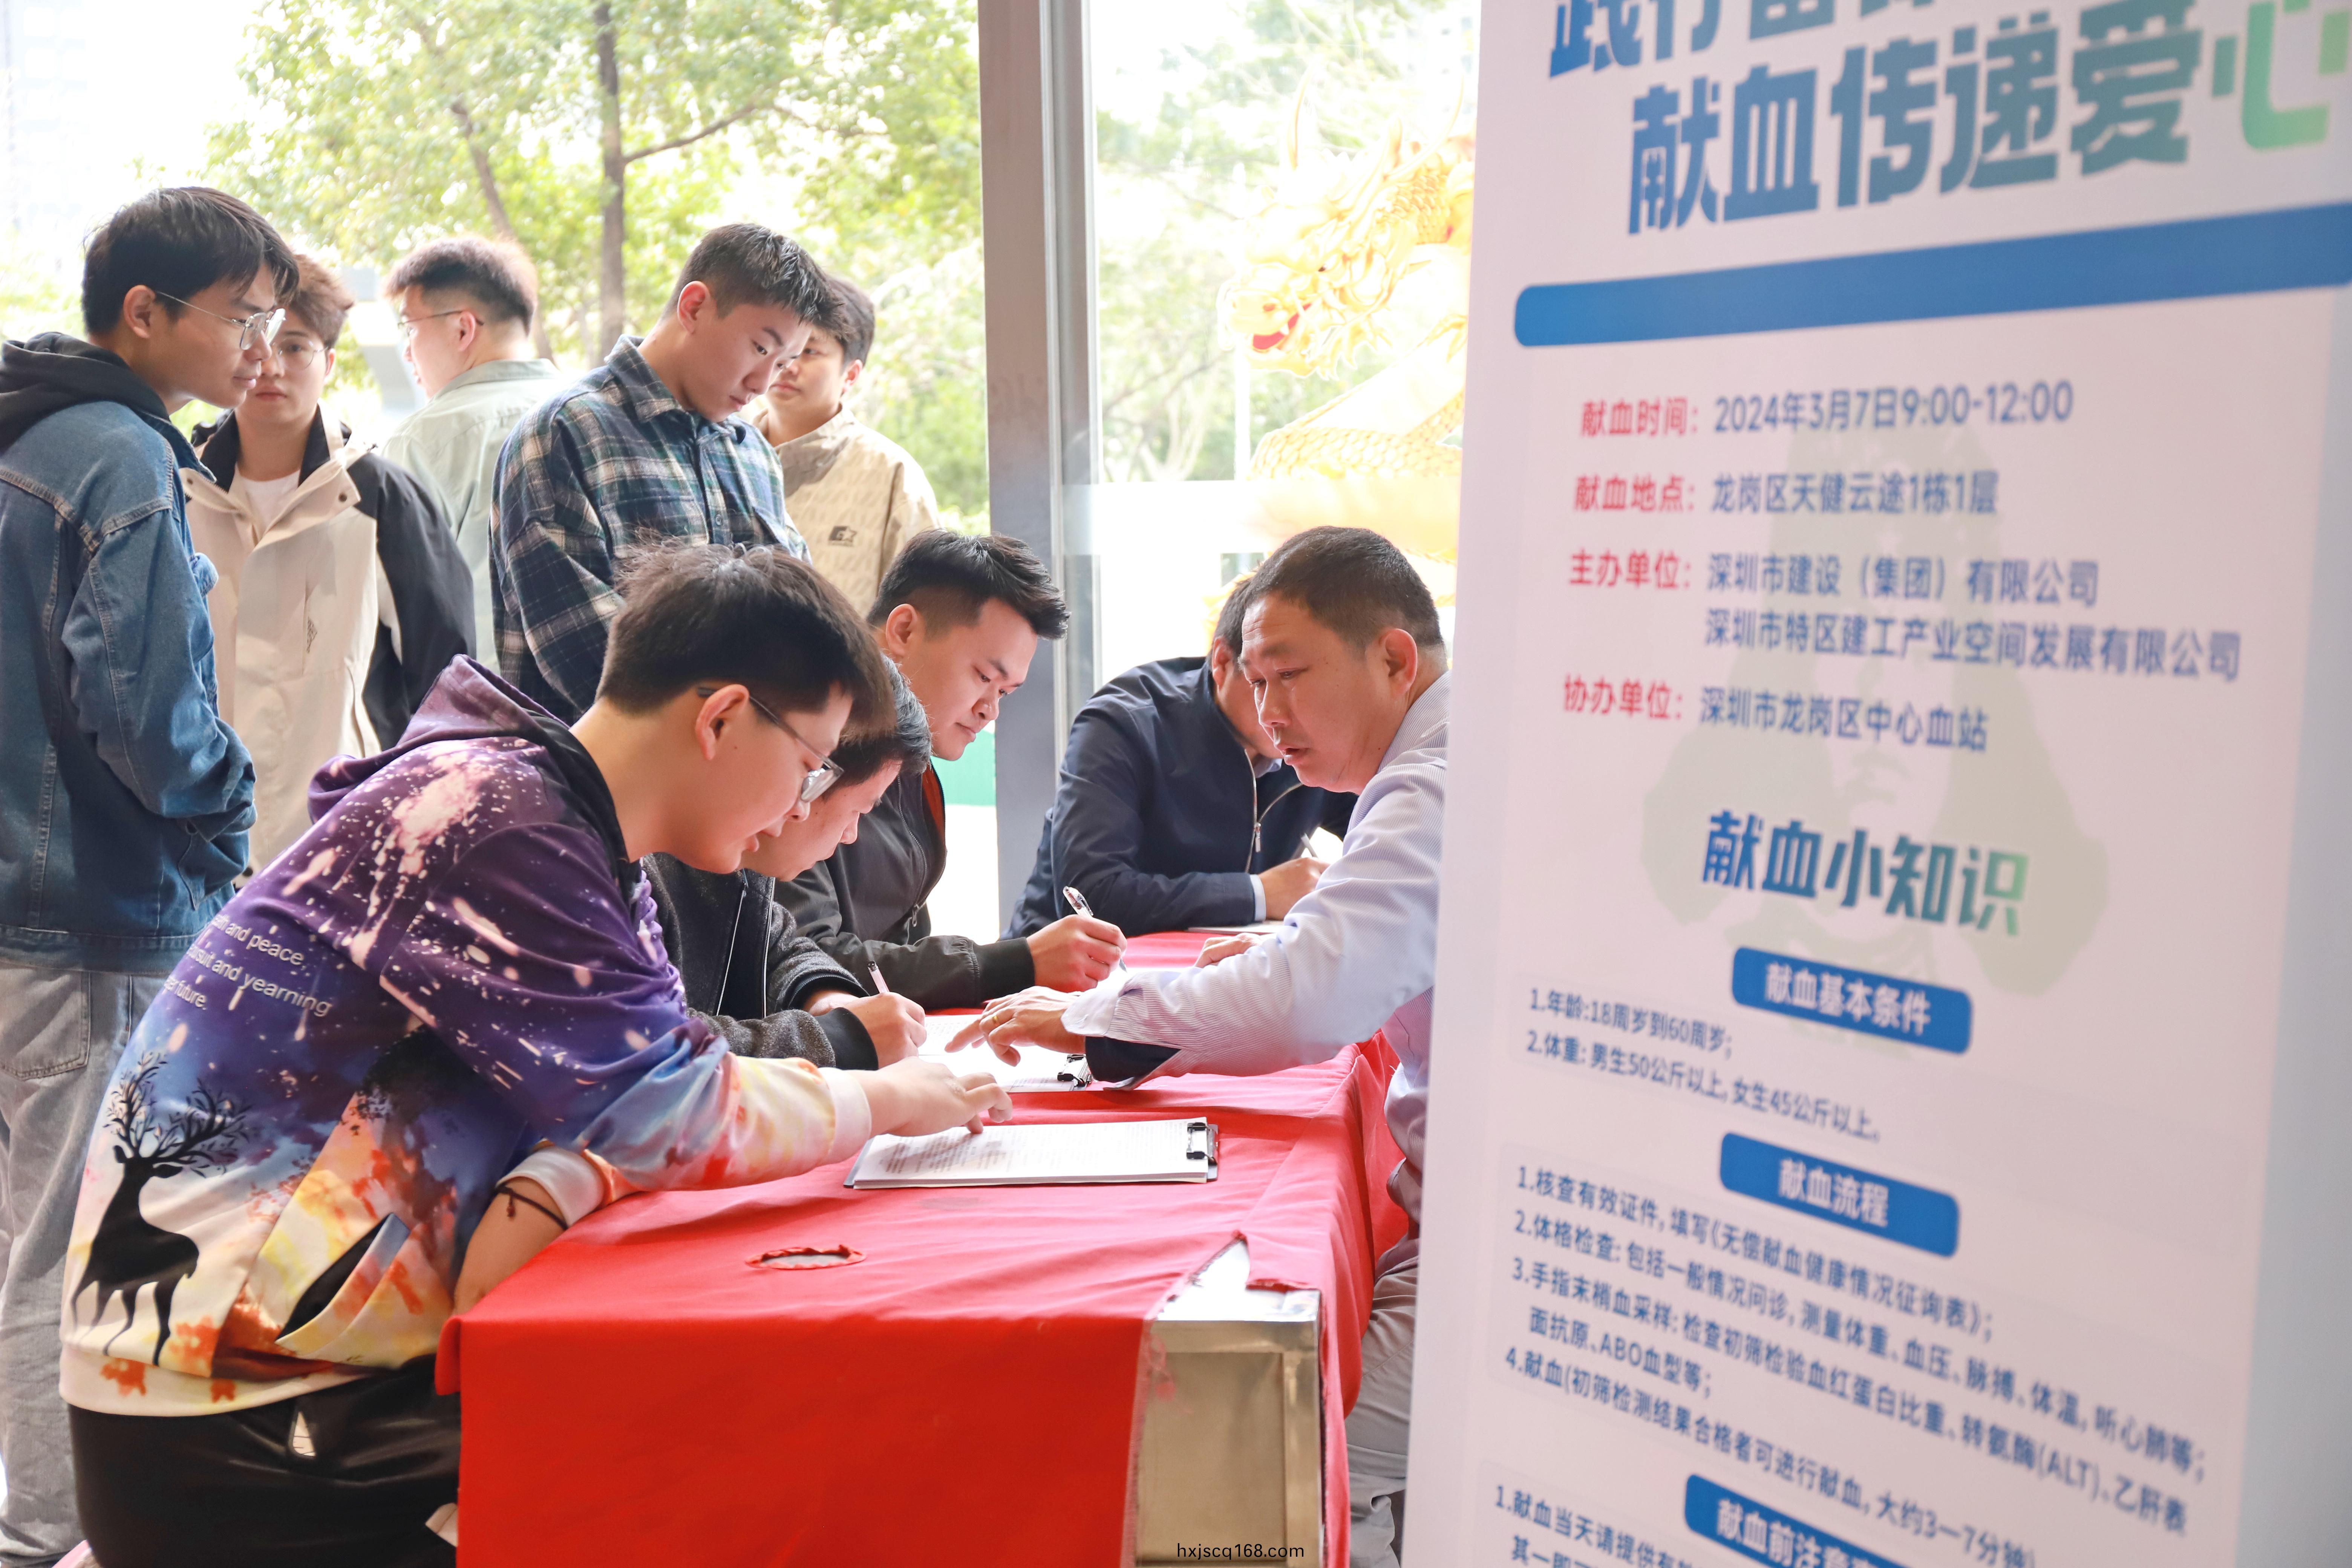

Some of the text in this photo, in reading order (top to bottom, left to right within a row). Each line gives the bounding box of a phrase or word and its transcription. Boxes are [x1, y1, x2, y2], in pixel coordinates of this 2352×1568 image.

[1628, 0, 2350, 234] 献血传递爱心
[1581, 379, 2074, 437] 献血时间： 2024年3月7日9:00-12:00
[1574, 469, 1999, 514] 献血地点： 龙岗区天健云途1栋1层
[1569, 548, 2099, 607] 主办单位： 深圳市建设（集团）有限公司
[1705, 608, 2241, 682] 深圳市特区建工产业空间发展有限公司
[1563, 673, 1988, 752] 协办单位： 深圳市龙岗区中心血站
[1701, 809, 2030, 937] 献血小知识
[225, 923, 253, 942] and
[211, 959, 244, 982] and
[237, 972, 333, 1018] yearning
[1764, 962, 1931, 1035] 献血基本条件
[1778, 1158, 1888, 1227] 献血流程
